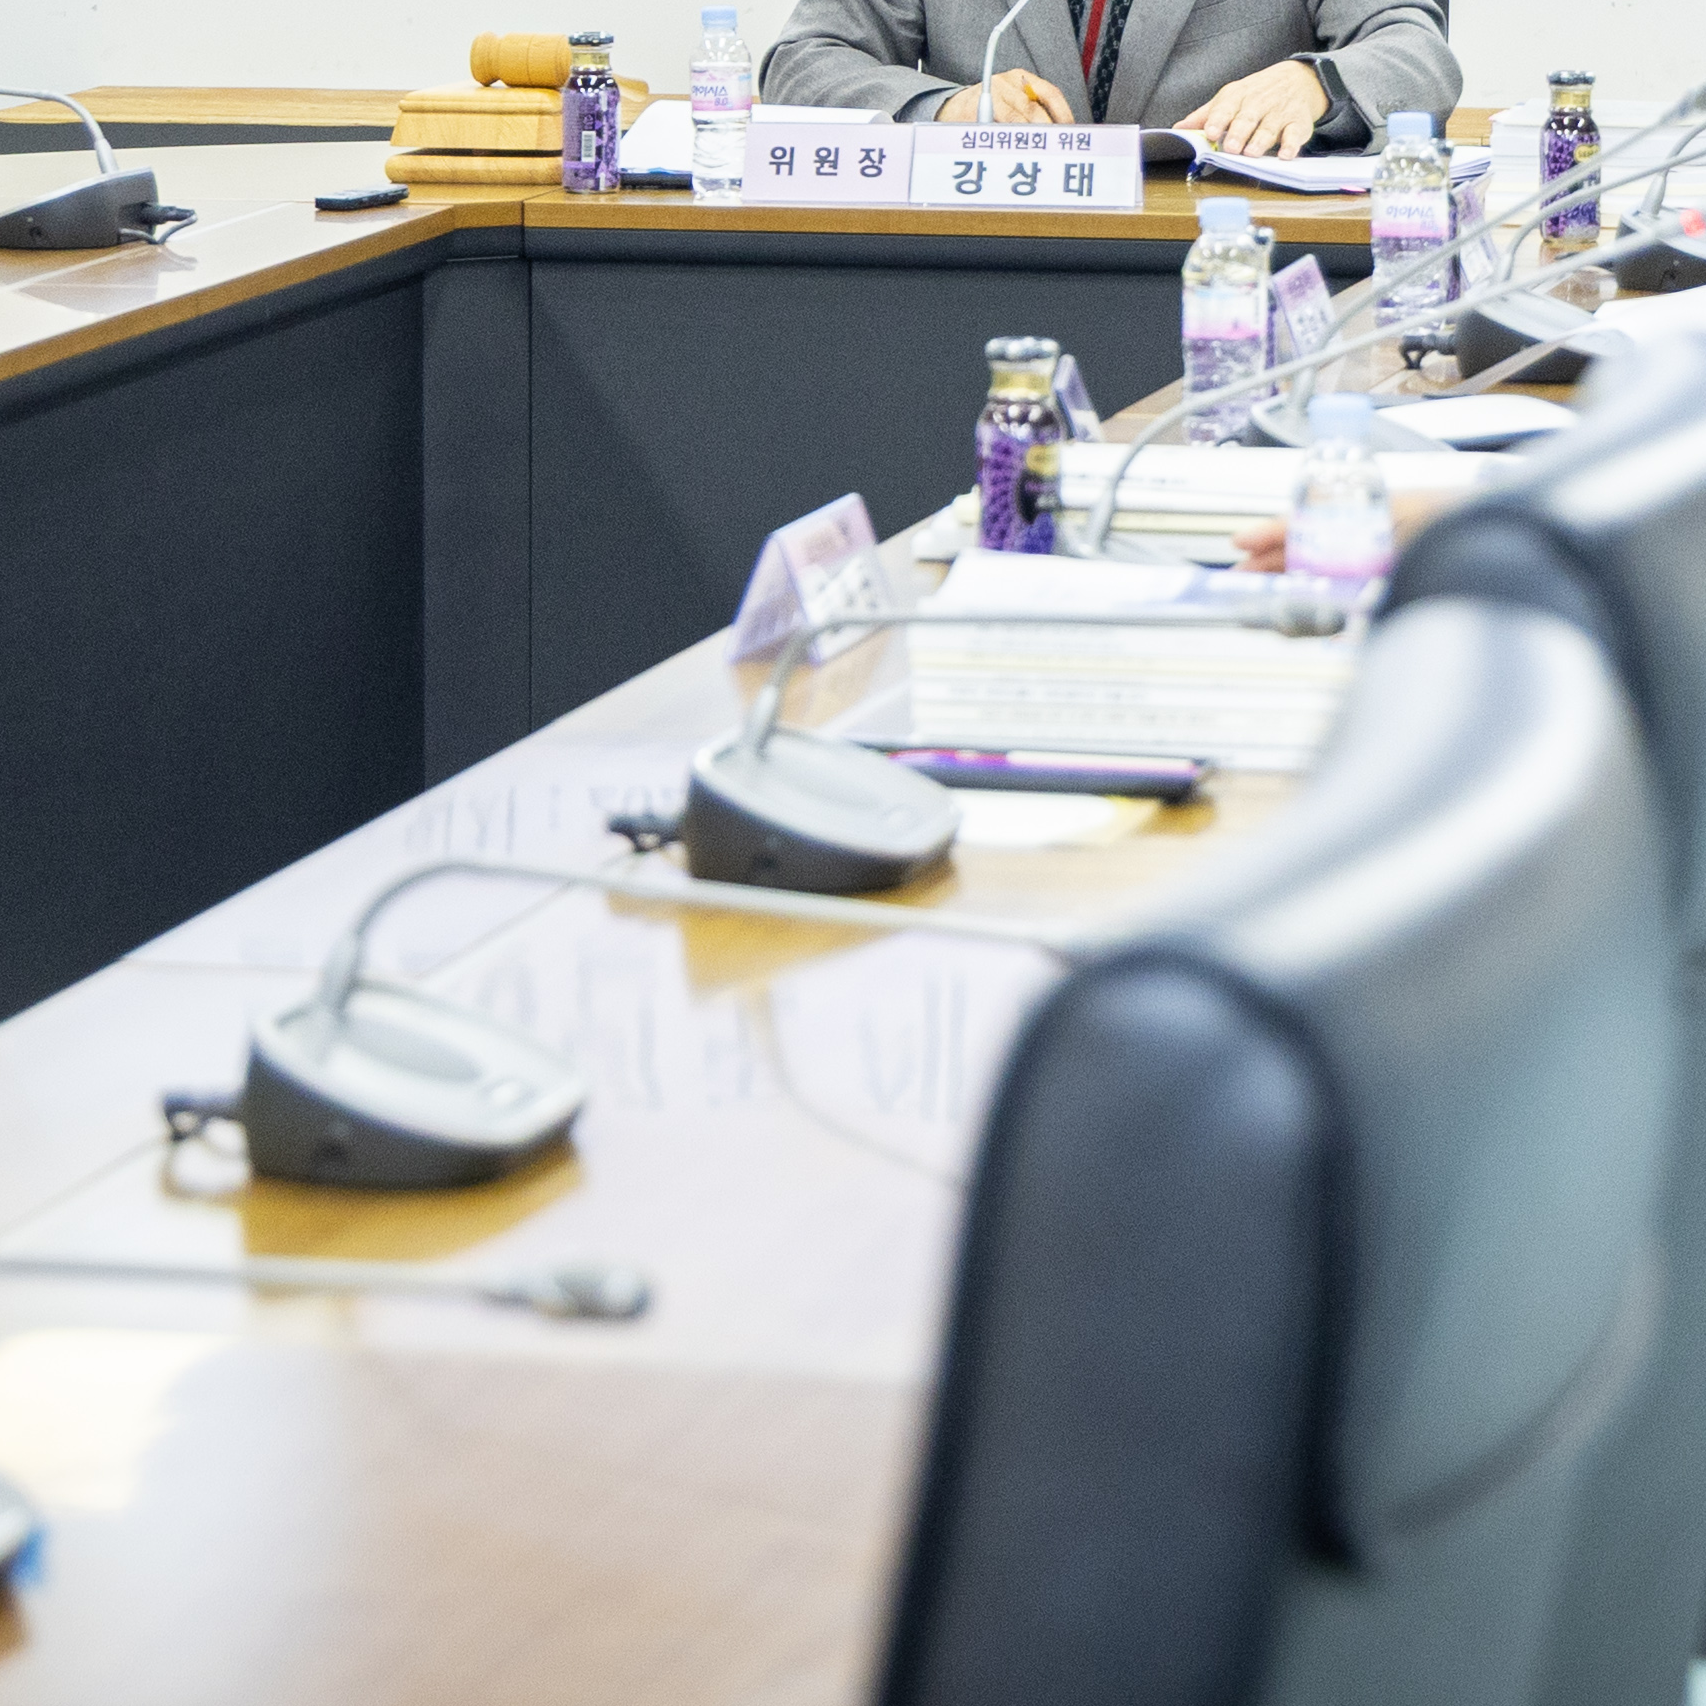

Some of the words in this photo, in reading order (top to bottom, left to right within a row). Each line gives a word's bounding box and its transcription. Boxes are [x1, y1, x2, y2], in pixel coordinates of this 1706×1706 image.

[961, 131, 1047, 149] 심의위원회
[1058, 132, 1092, 151] 위원
[768, 146, 886, 177] 위원장
[952, 160, 1095, 197] 강상태
